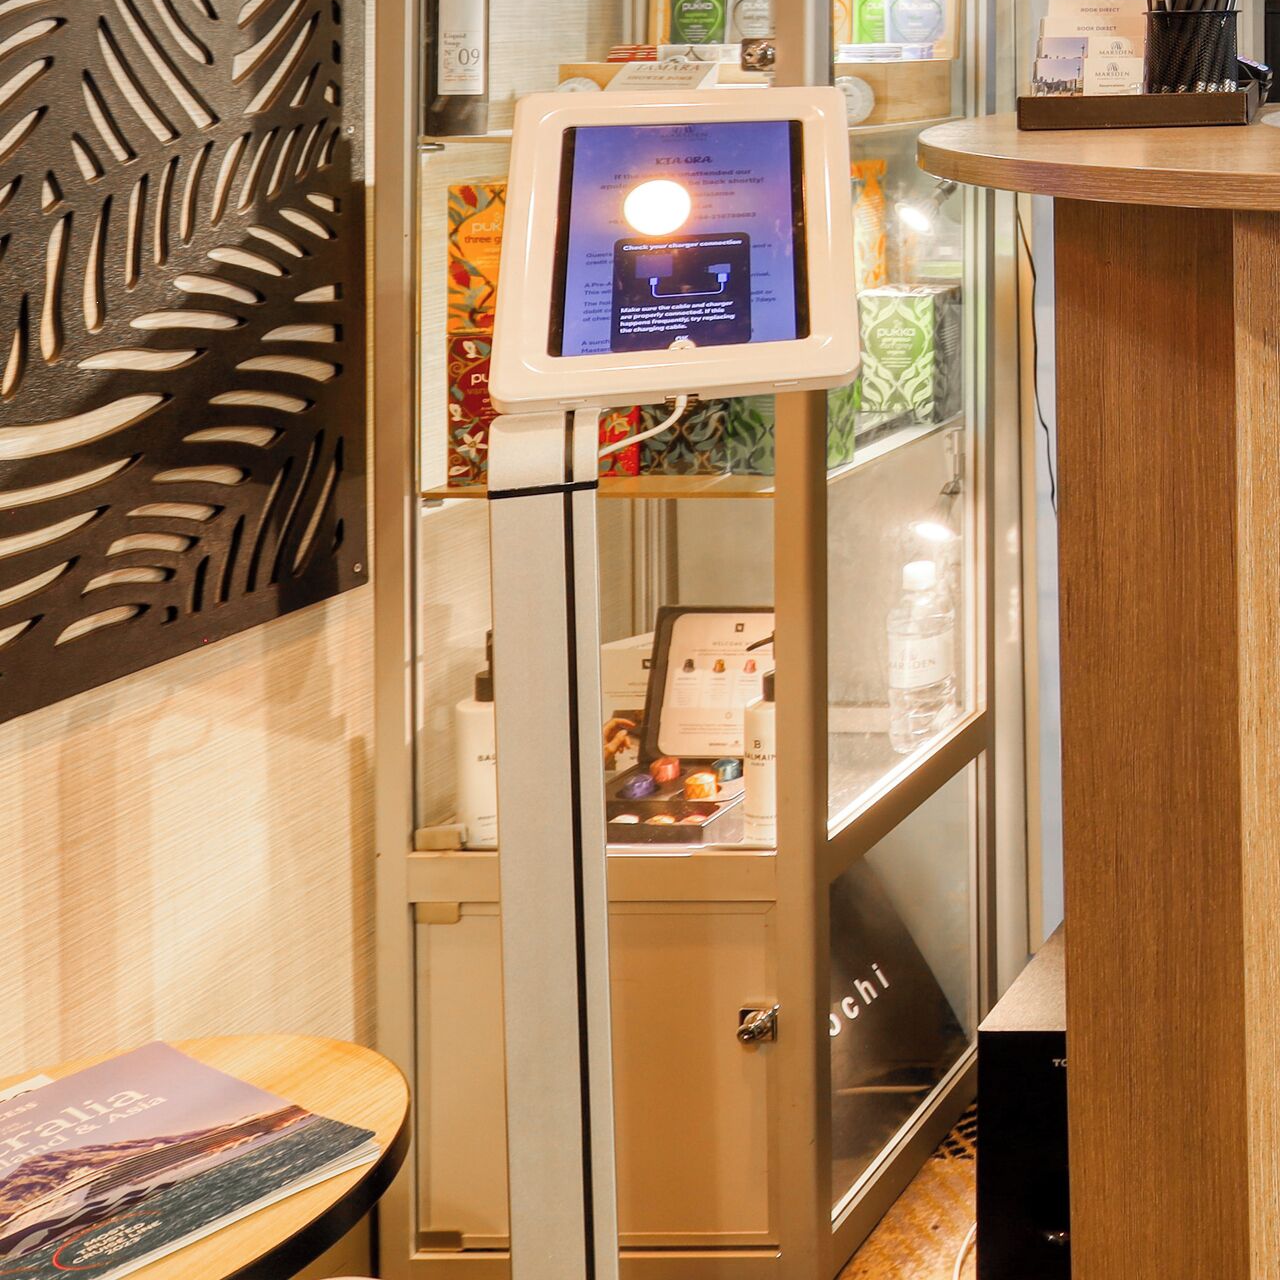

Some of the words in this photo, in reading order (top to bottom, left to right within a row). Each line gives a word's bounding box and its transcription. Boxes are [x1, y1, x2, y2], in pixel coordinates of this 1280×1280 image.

[682, 1, 713, 12] pukka
[458, 47, 480, 65] 09
[655, 156, 682, 166] KIA
[684, 155, 713, 165] ORA
[463, 235, 492, 244] three
[622, 244, 649, 252] Check
[649, 243, 668, 252] your
[668, 241, 700, 251] charger
[700, 238, 743, 247] connection
[620, 305, 640, 314] Make
[658, 304, 671, 312] the
[671, 302, 691, 311] cable
[691, 301, 706, 310] and
[705, 299, 734, 309] charger
[633, 311, 665, 321] properly
[665, 308, 704, 318] connected.
[711, 307, 725, 315] this
[619, 318, 651, 328] happens
[651, 315, 690, 326] frequently,
[691, 315, 702, 324] try
[702, 312, 736, 323] replacing
[619, 326, 632, 334] the
[631, 324, 665, 334] charging
[665, 322, 688, 331] cable.
[876, 327, 917, 339] pukka
[753, 739, 762, 750] B
[829, 962, 891, 1038] ochi
[0, 1090, 149, 1157] ralia
[0, 1133, 70, 1169] land
[74, 1124, 103, 1136] &
[109, 1096, 168, 1123] Asia
[72, 1237, 129, 1265] CRUISE
[128, 1220, 163, 1239] LINE
[75, 1222, 146, 1256] TRUSTED
[83, 1223, 128, 1247] MOST
